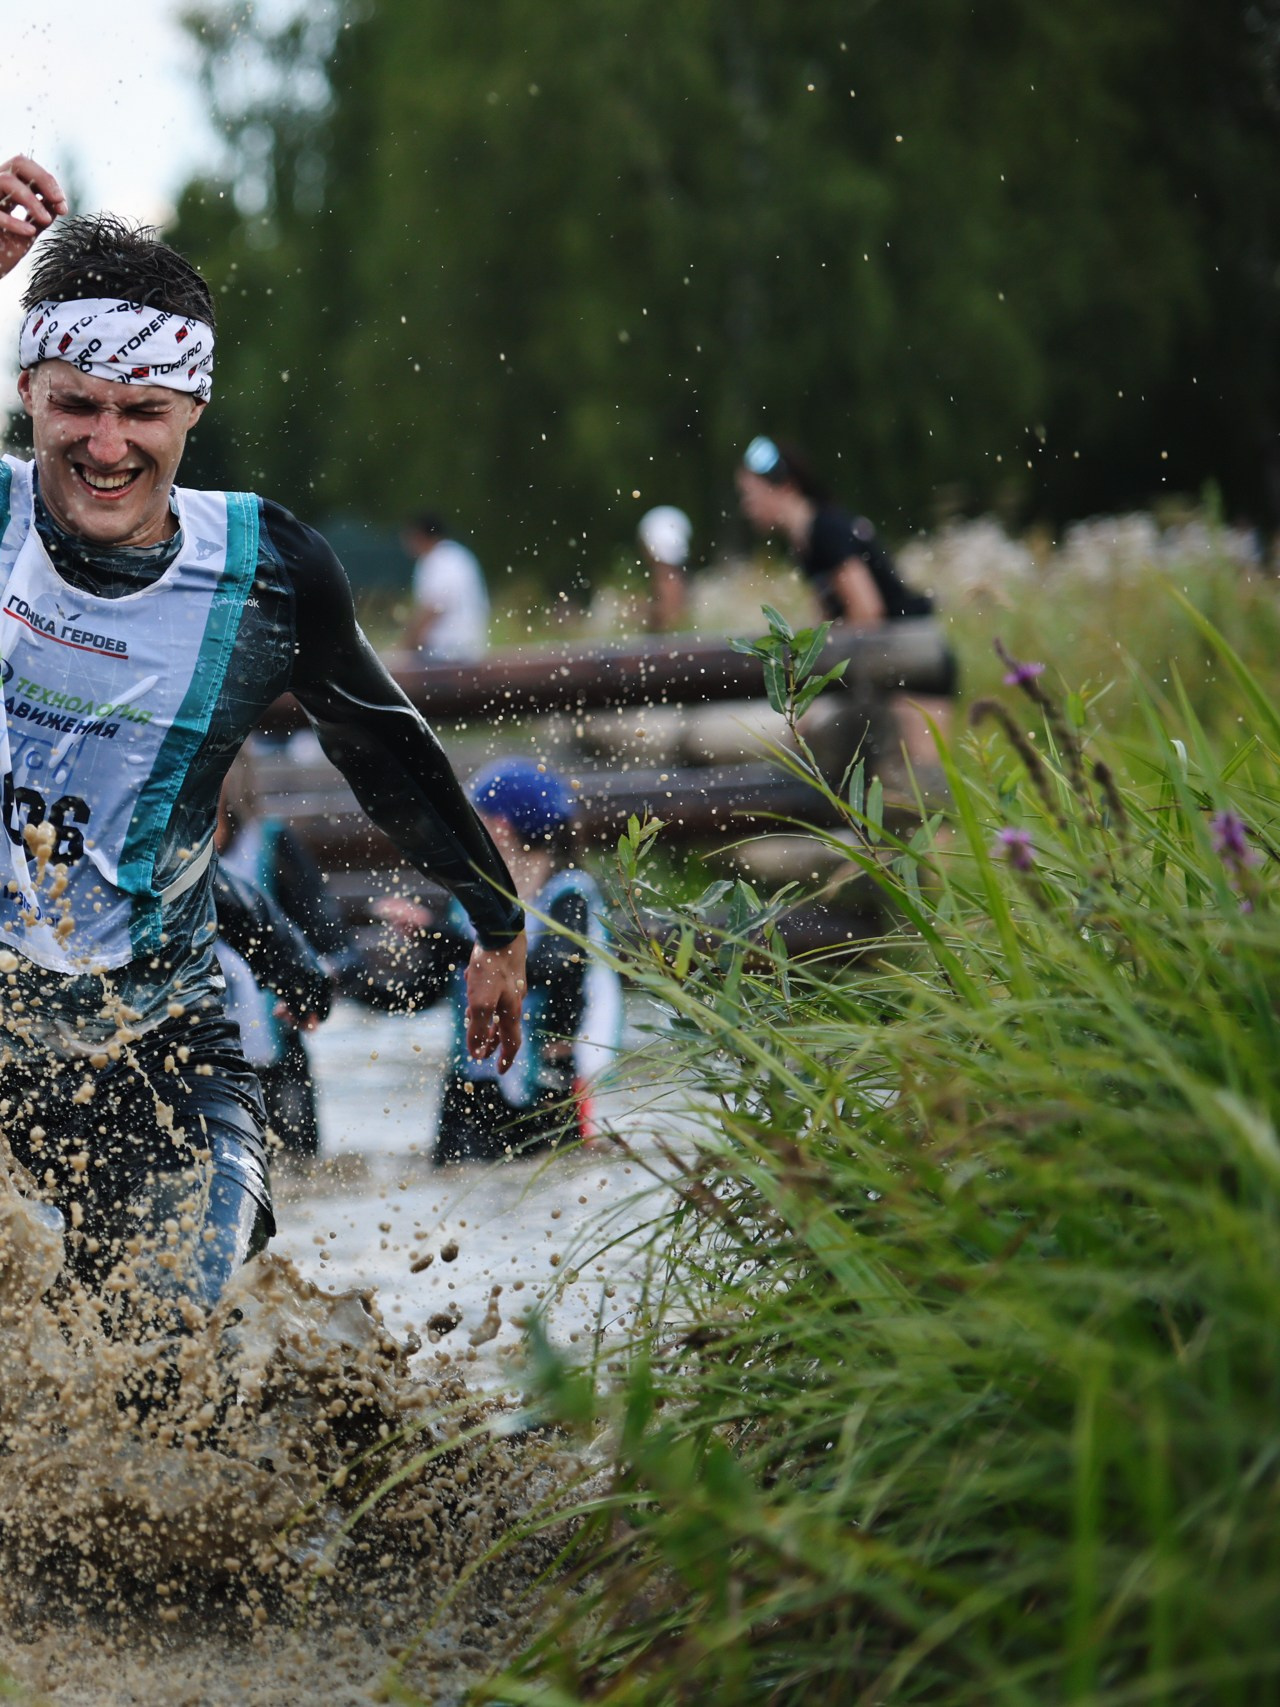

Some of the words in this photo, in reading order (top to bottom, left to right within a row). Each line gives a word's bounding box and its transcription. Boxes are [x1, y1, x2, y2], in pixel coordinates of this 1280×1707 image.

[151, 341, 202, 376] TORERO
[7, 595, 56, 636] ГОНКА
[60, 627, 128, 653] ГЕРОЕВ
[4, 696, 120, 739] ДВИЖЕНИЯ
[16, 677, 153, 725] ТЕХНОЛОГИЯ
